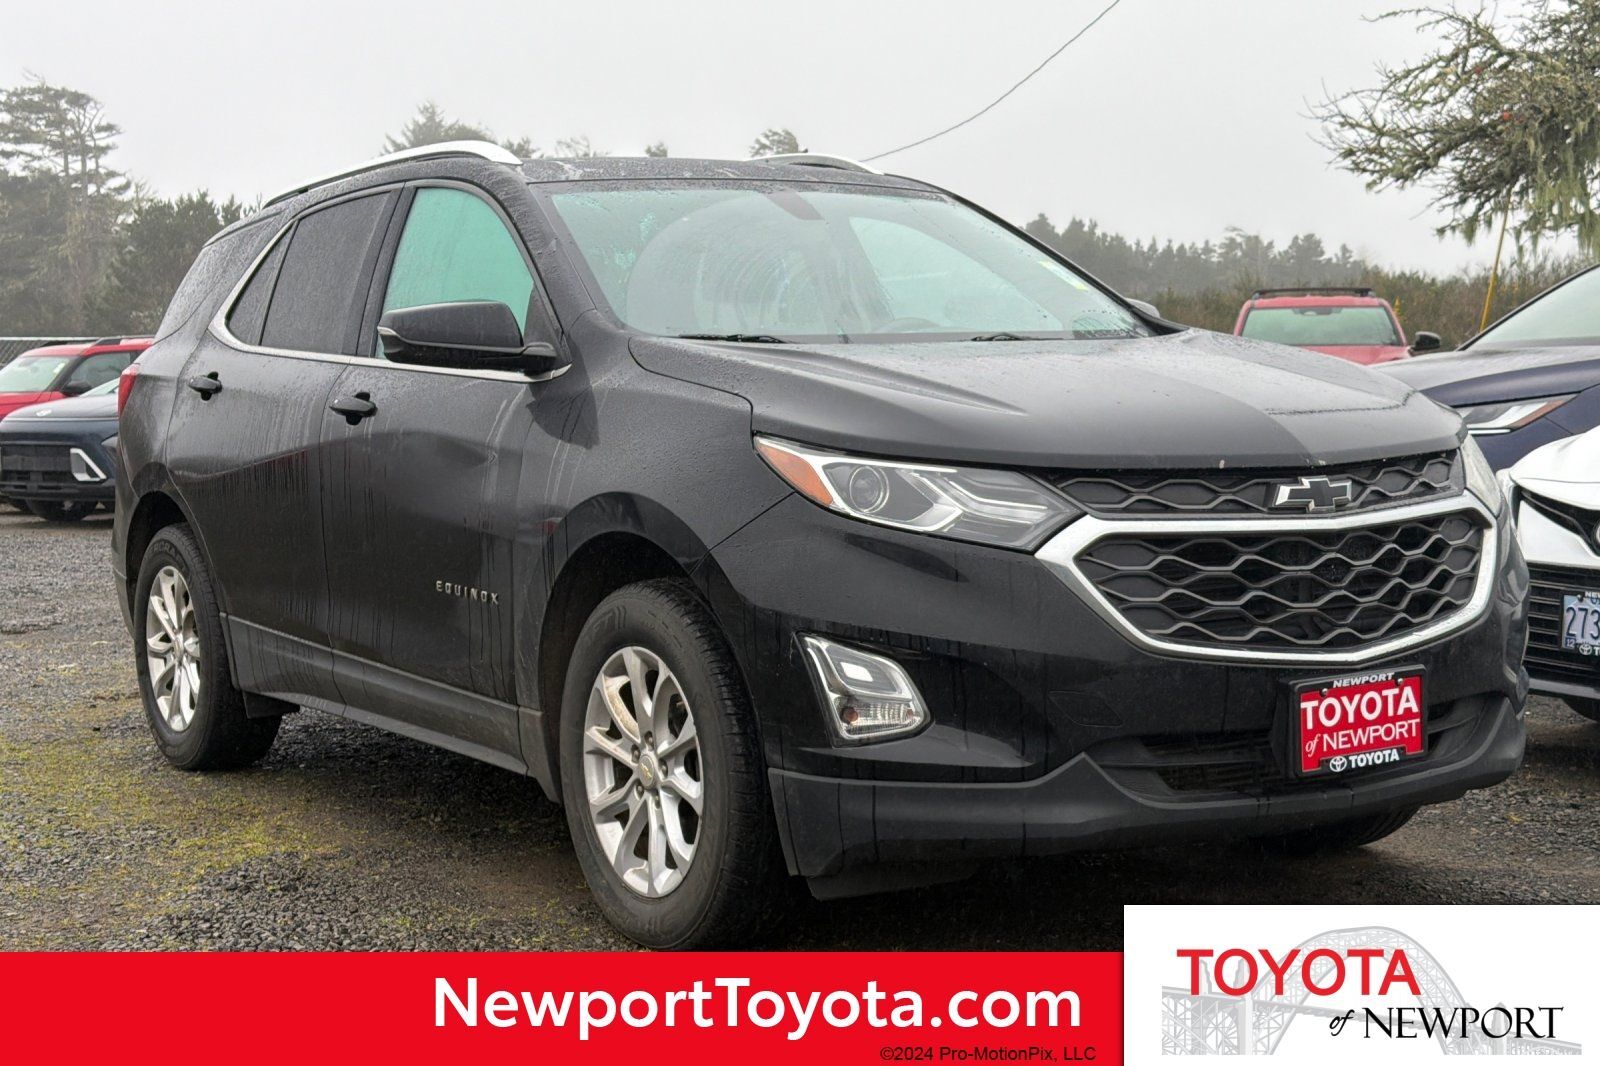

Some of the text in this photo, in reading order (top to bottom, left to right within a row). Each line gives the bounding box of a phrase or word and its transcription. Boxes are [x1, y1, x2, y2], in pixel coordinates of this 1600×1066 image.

[435, 580, 499, 605] EQUINOX
[1332, 672, 1395, 689] NEWPORT
[1300, 686, 1419, 730] TOYOTA
[1305, 718, 1420, 758] of NEWPORT
[1349, 748, 1400, 768] TOYOTA
